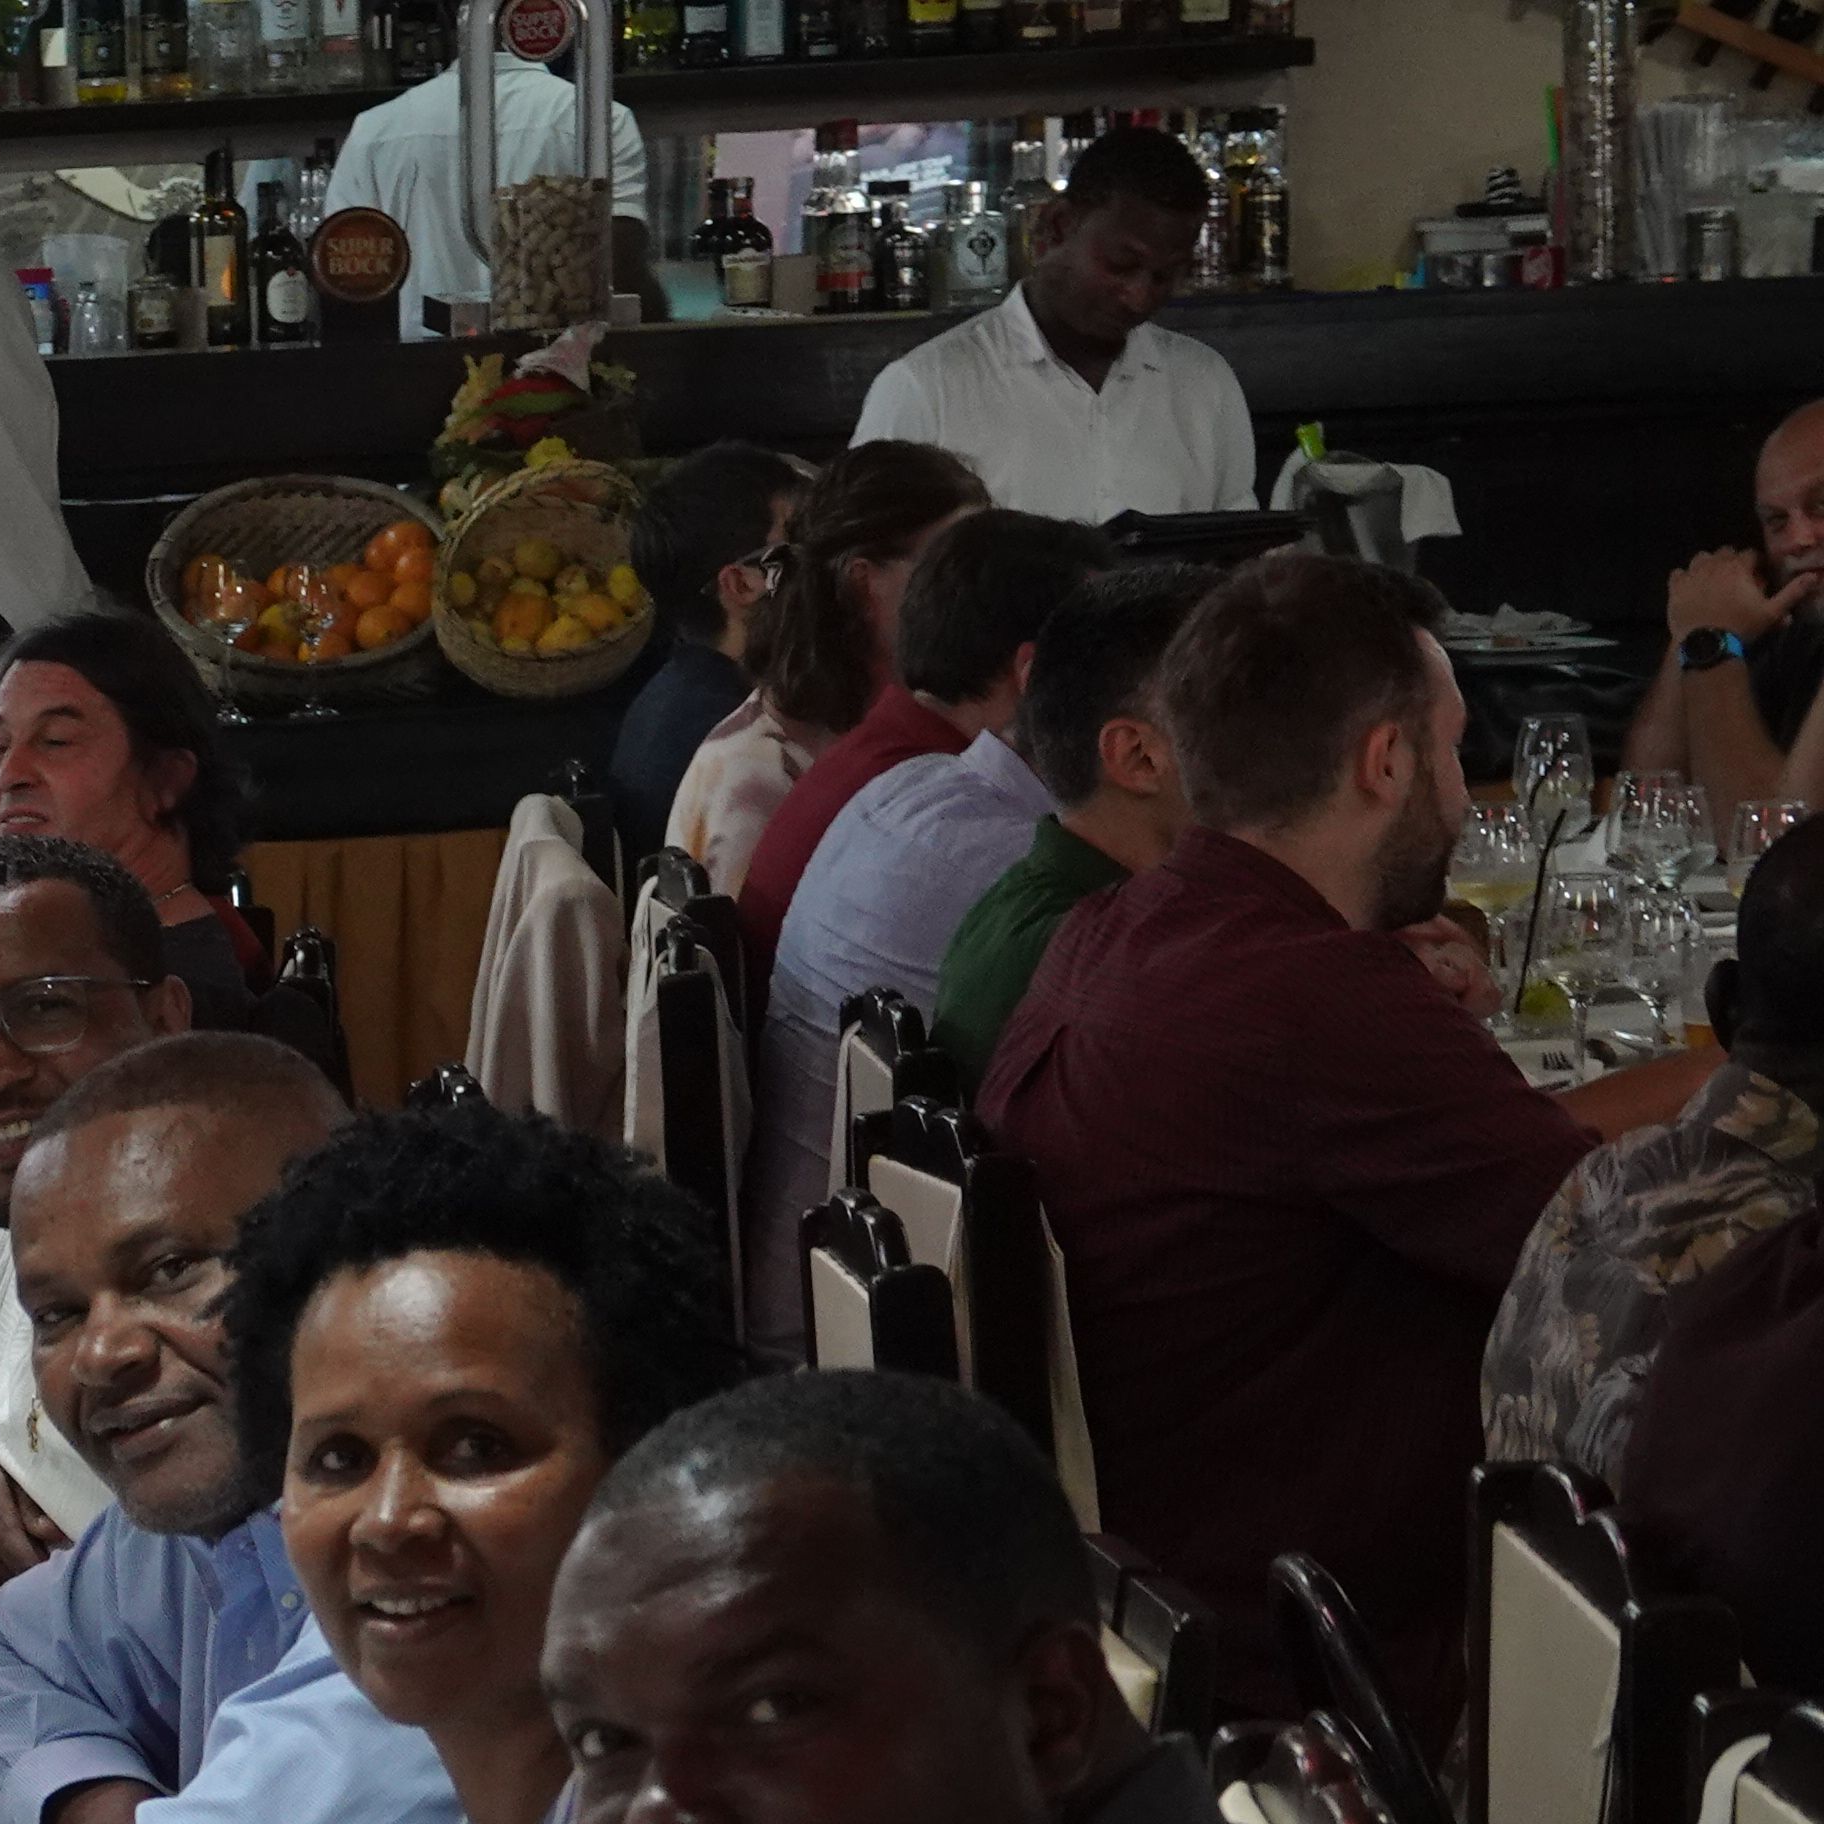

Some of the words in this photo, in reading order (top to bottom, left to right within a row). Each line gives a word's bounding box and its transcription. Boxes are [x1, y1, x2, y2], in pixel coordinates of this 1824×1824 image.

[511, 10, 564, 27] SUPER
[514, 24, 563, 41] BOCK
[325, 236, 395, 257] SUPER
[329, 257, 393, 276] BOCK
